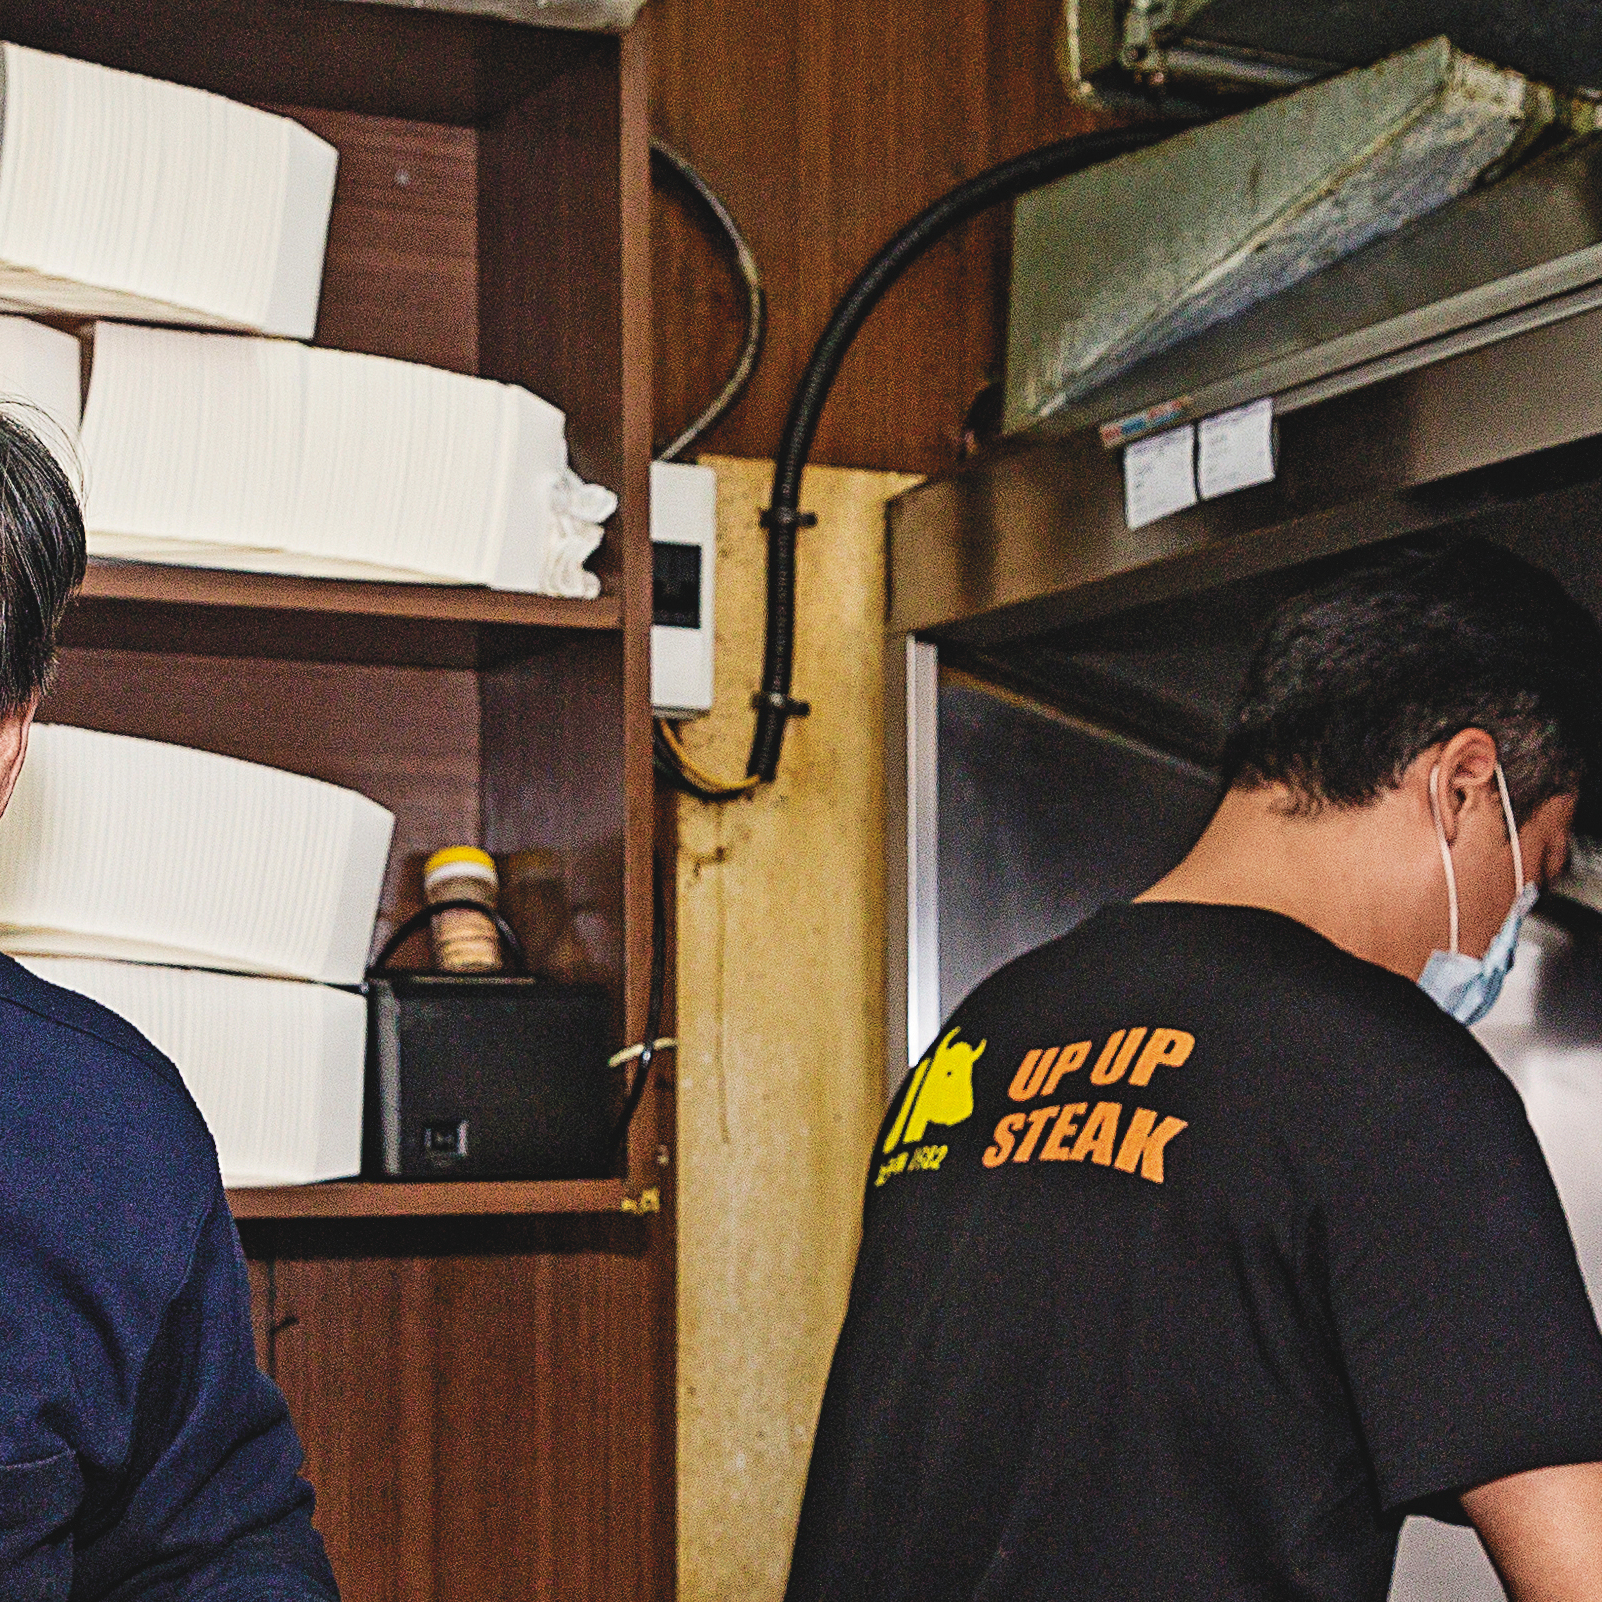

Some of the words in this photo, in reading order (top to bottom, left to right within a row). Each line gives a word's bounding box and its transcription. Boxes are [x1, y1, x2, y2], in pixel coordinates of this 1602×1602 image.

[1007, 1040, 1093, 1103] UP
[1089, 1026, 1196, 1087] UP
[981, 1100, 1189, 1184] STEAK
